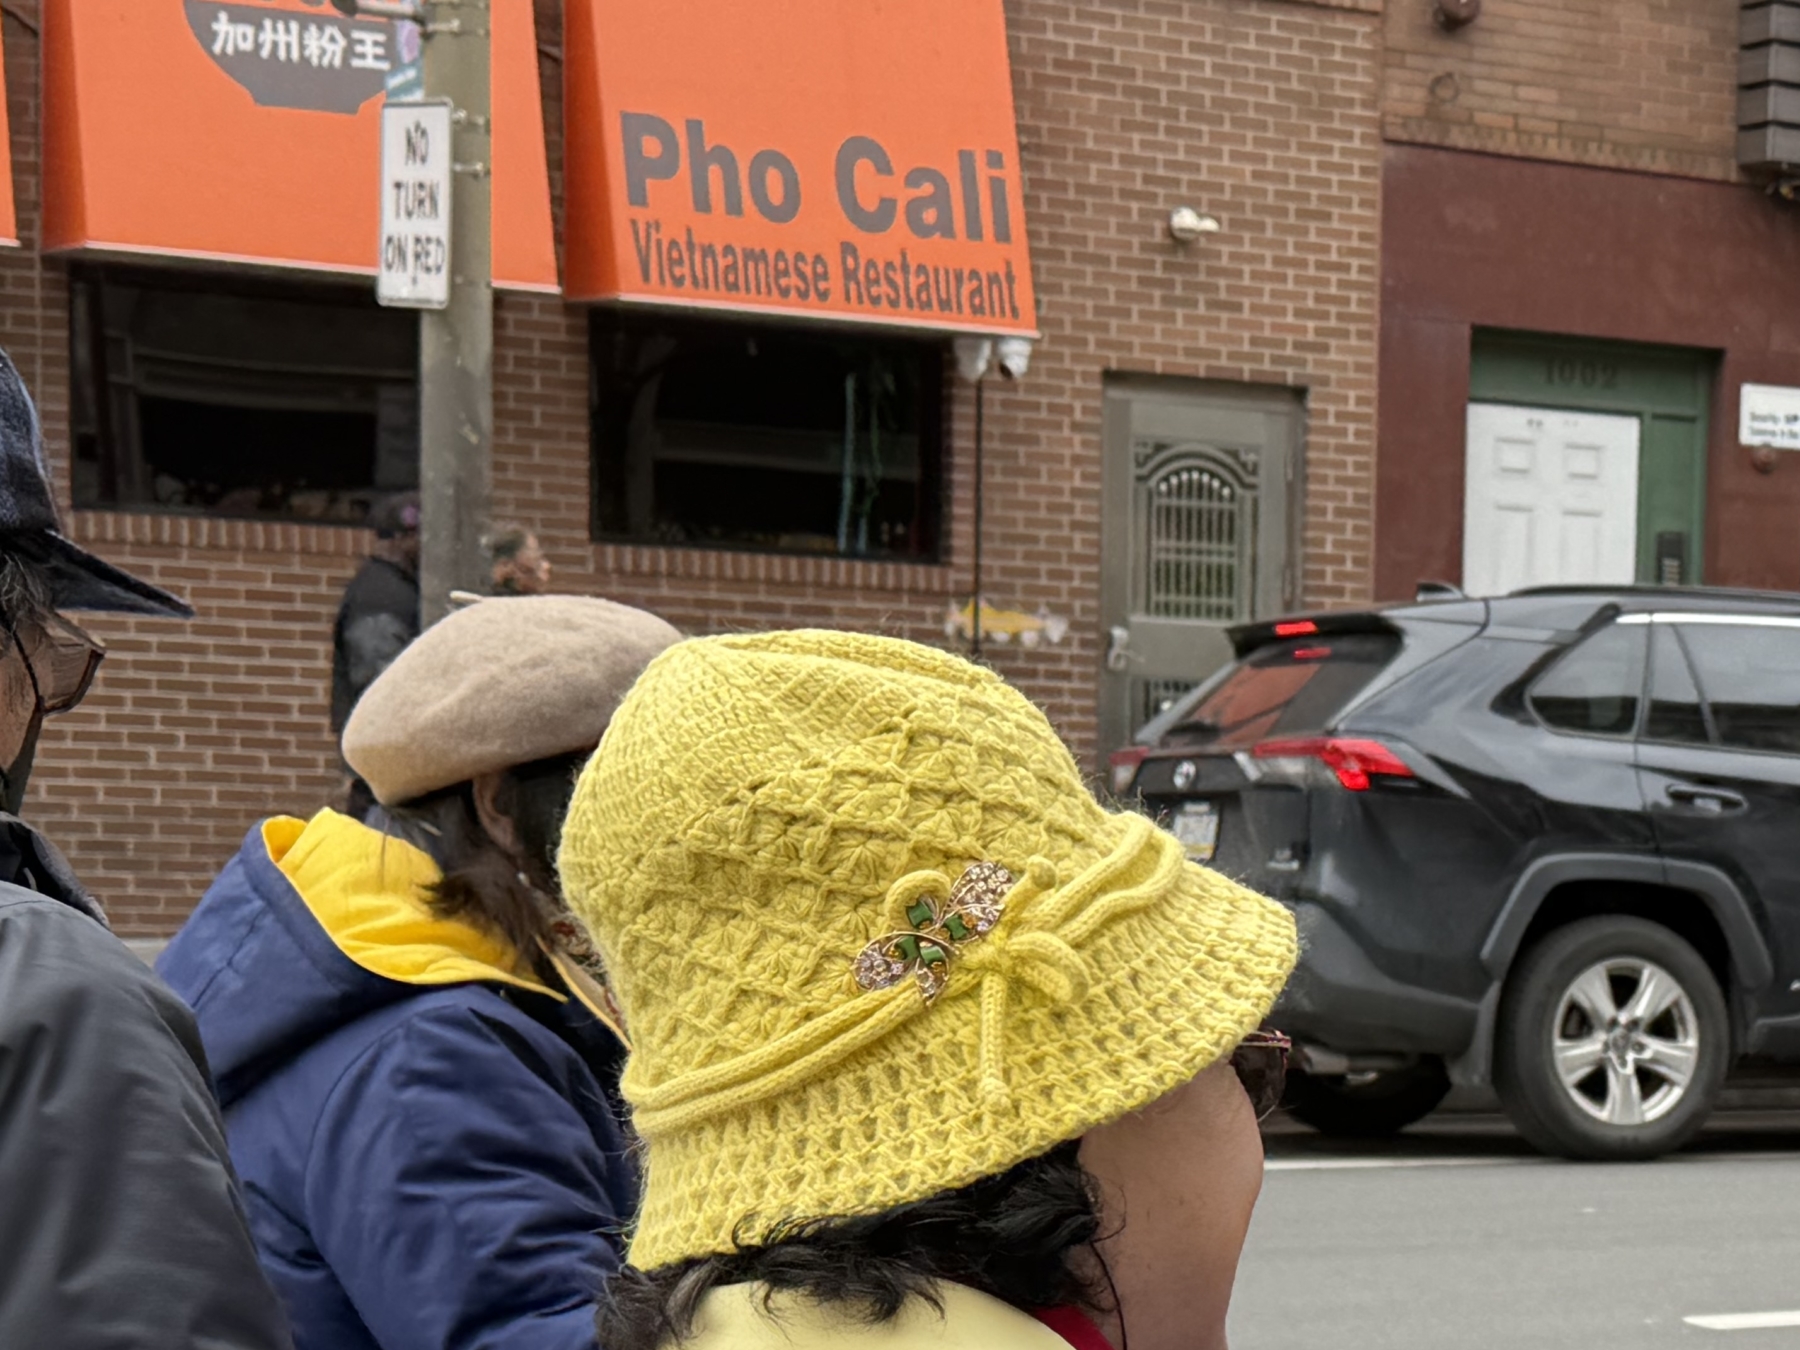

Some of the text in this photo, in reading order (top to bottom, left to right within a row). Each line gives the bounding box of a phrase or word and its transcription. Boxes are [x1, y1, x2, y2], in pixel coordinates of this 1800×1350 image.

[211, 10, 391, 71] 加州粉王
[405, 124, 429, 166] NO
[393, 180, 440, 219] TURN
[620, 110, 1011, 244] Pho Cali
[384, 235, 446, 275] ON RED
[630, 218, 1020, 321] Vietnamese Restaurant
